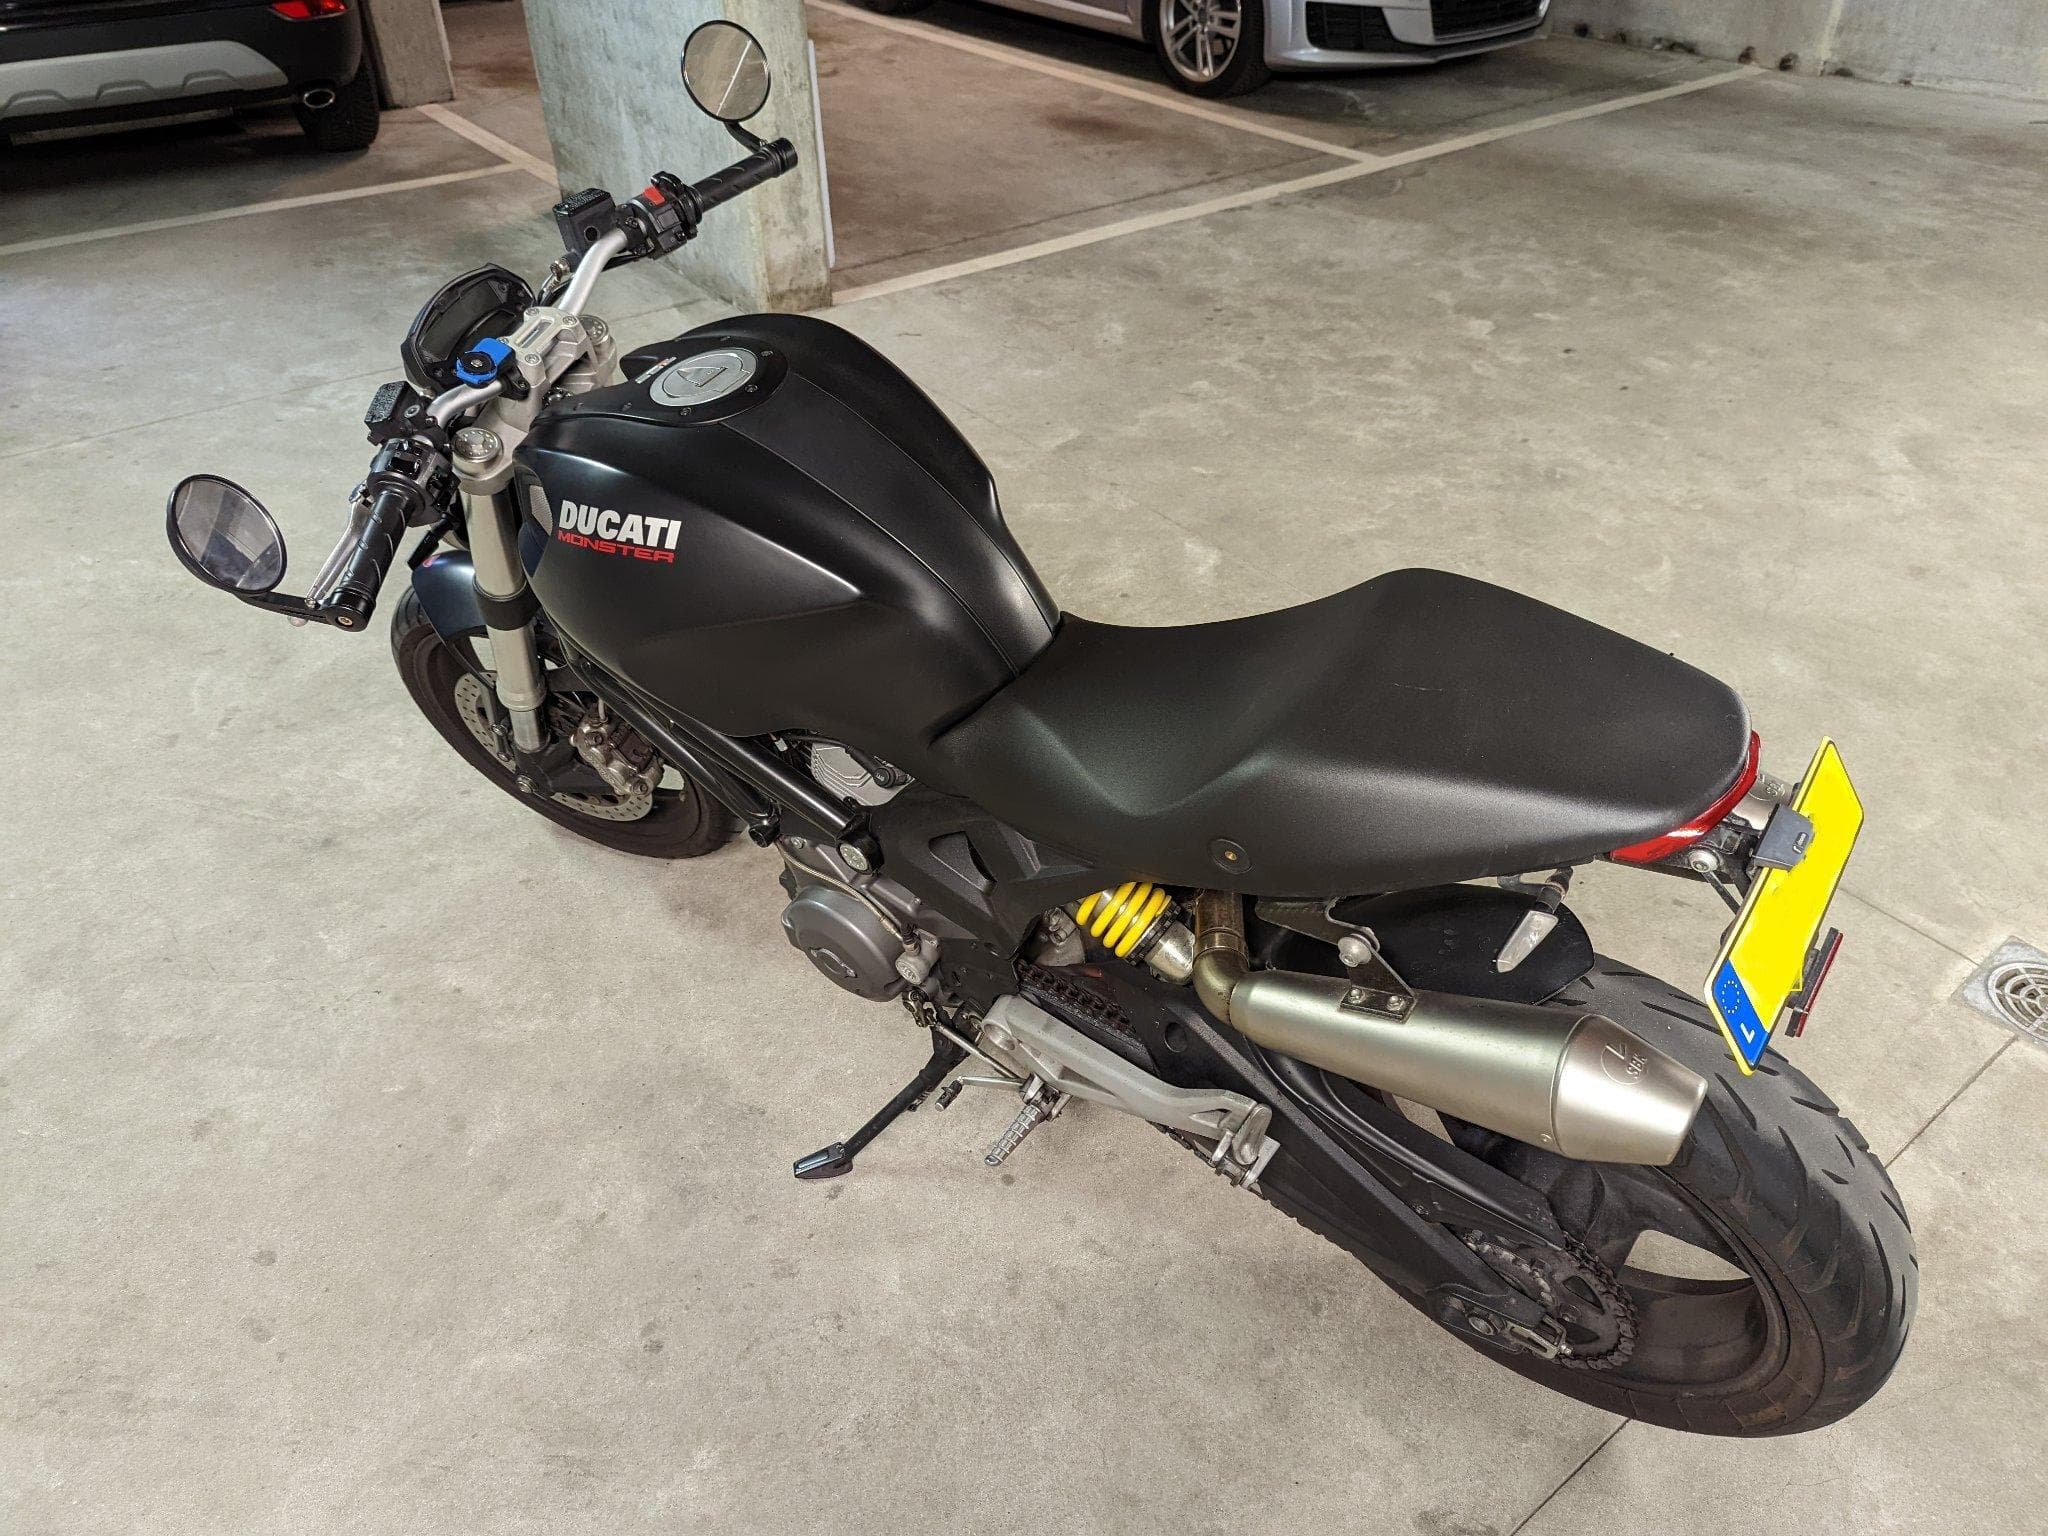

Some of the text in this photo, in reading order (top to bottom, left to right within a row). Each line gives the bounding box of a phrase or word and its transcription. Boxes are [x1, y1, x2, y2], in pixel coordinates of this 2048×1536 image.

[558, 499, 682, 550] DUCATI
[558, 530, 676, 563] MONSTER
[1740, 1022, 1756, 1044] L
